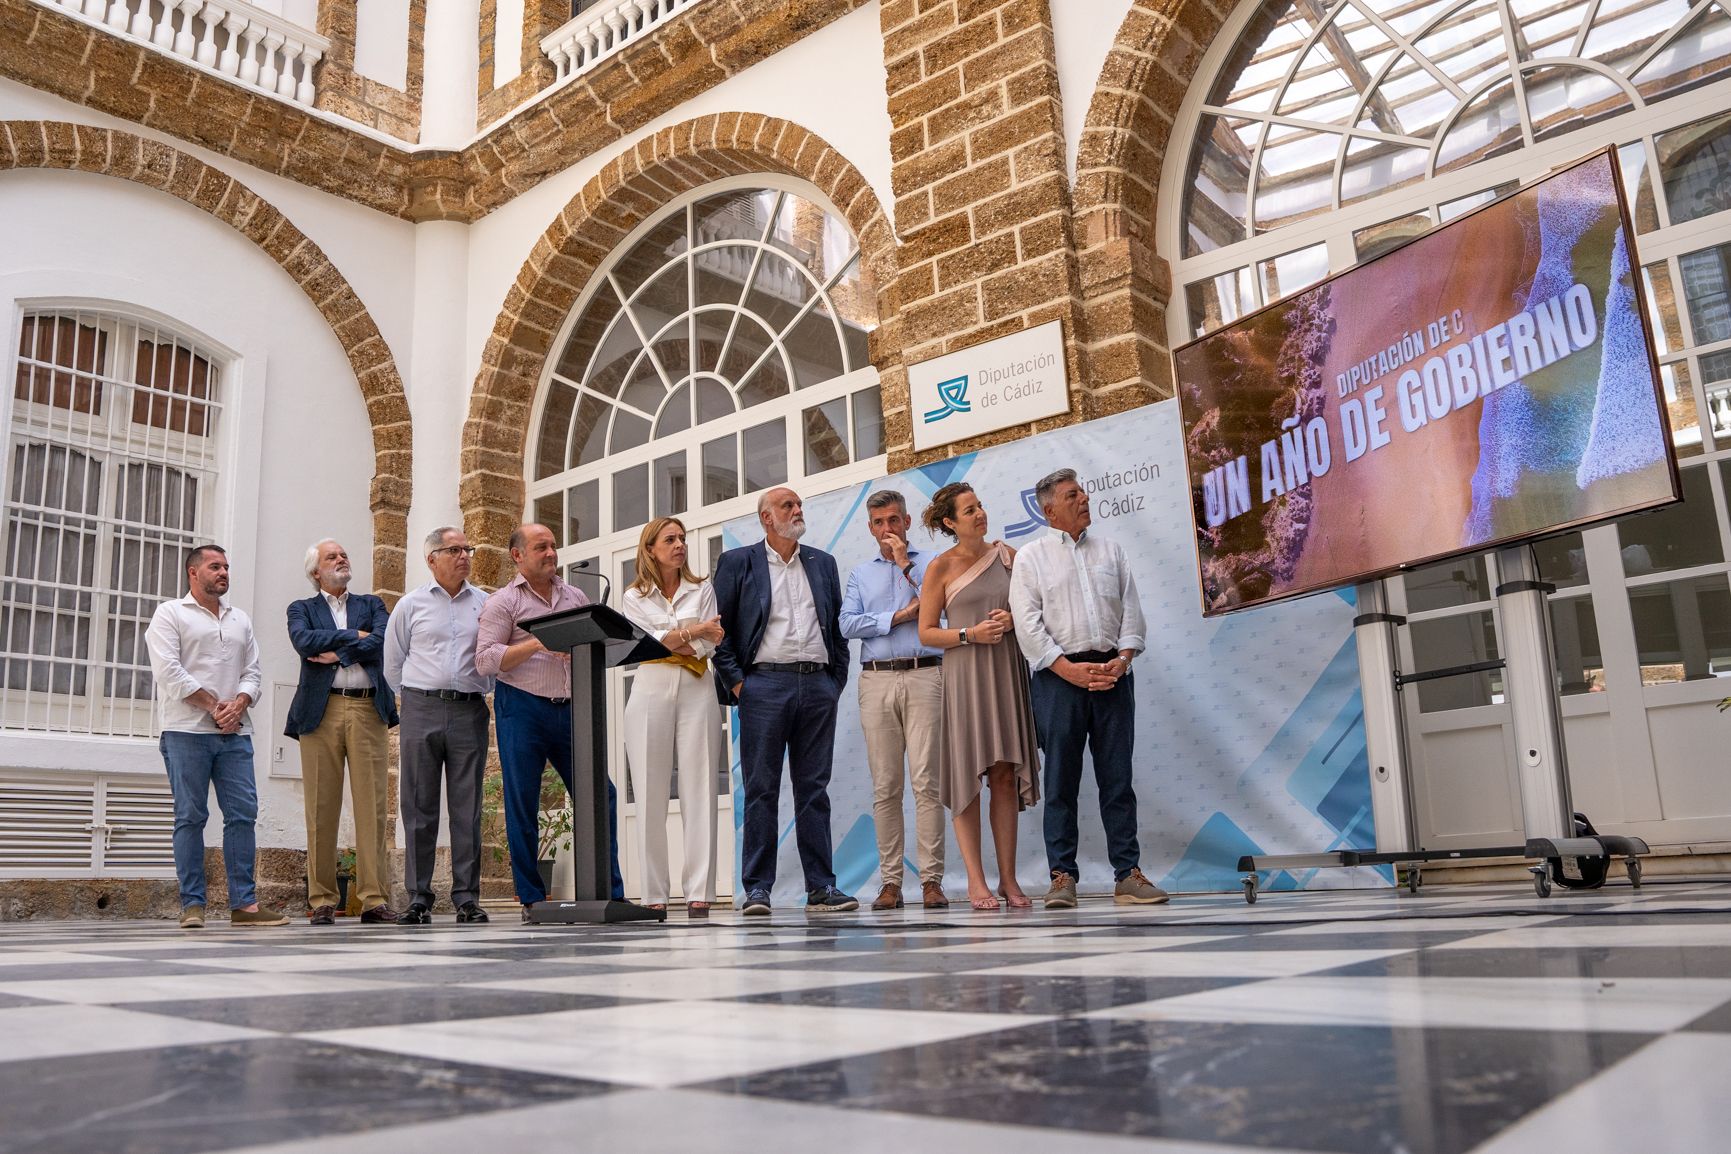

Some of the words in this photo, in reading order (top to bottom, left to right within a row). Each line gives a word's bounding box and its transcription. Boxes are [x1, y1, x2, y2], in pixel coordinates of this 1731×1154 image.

[978, 352, 1055, 386] Diputación
[1337, 330, 1425, 399] DIPUTACIÓN
[1427, 315, 1451, 349] DE
[981, 391, 998, 408] de
[1003, 378, 1043, 402] Cádiz
[1202, 455, 1252, 528] UN
[1261, 414, 1331, 504] AÑO
[1340, 384, 1391, 464] DE
[1396, 283, 1598, 433] GOBIERNO
[1080, 462, 1160, 495] iputación
[1098, 492, 1145, 519] Cádiz
